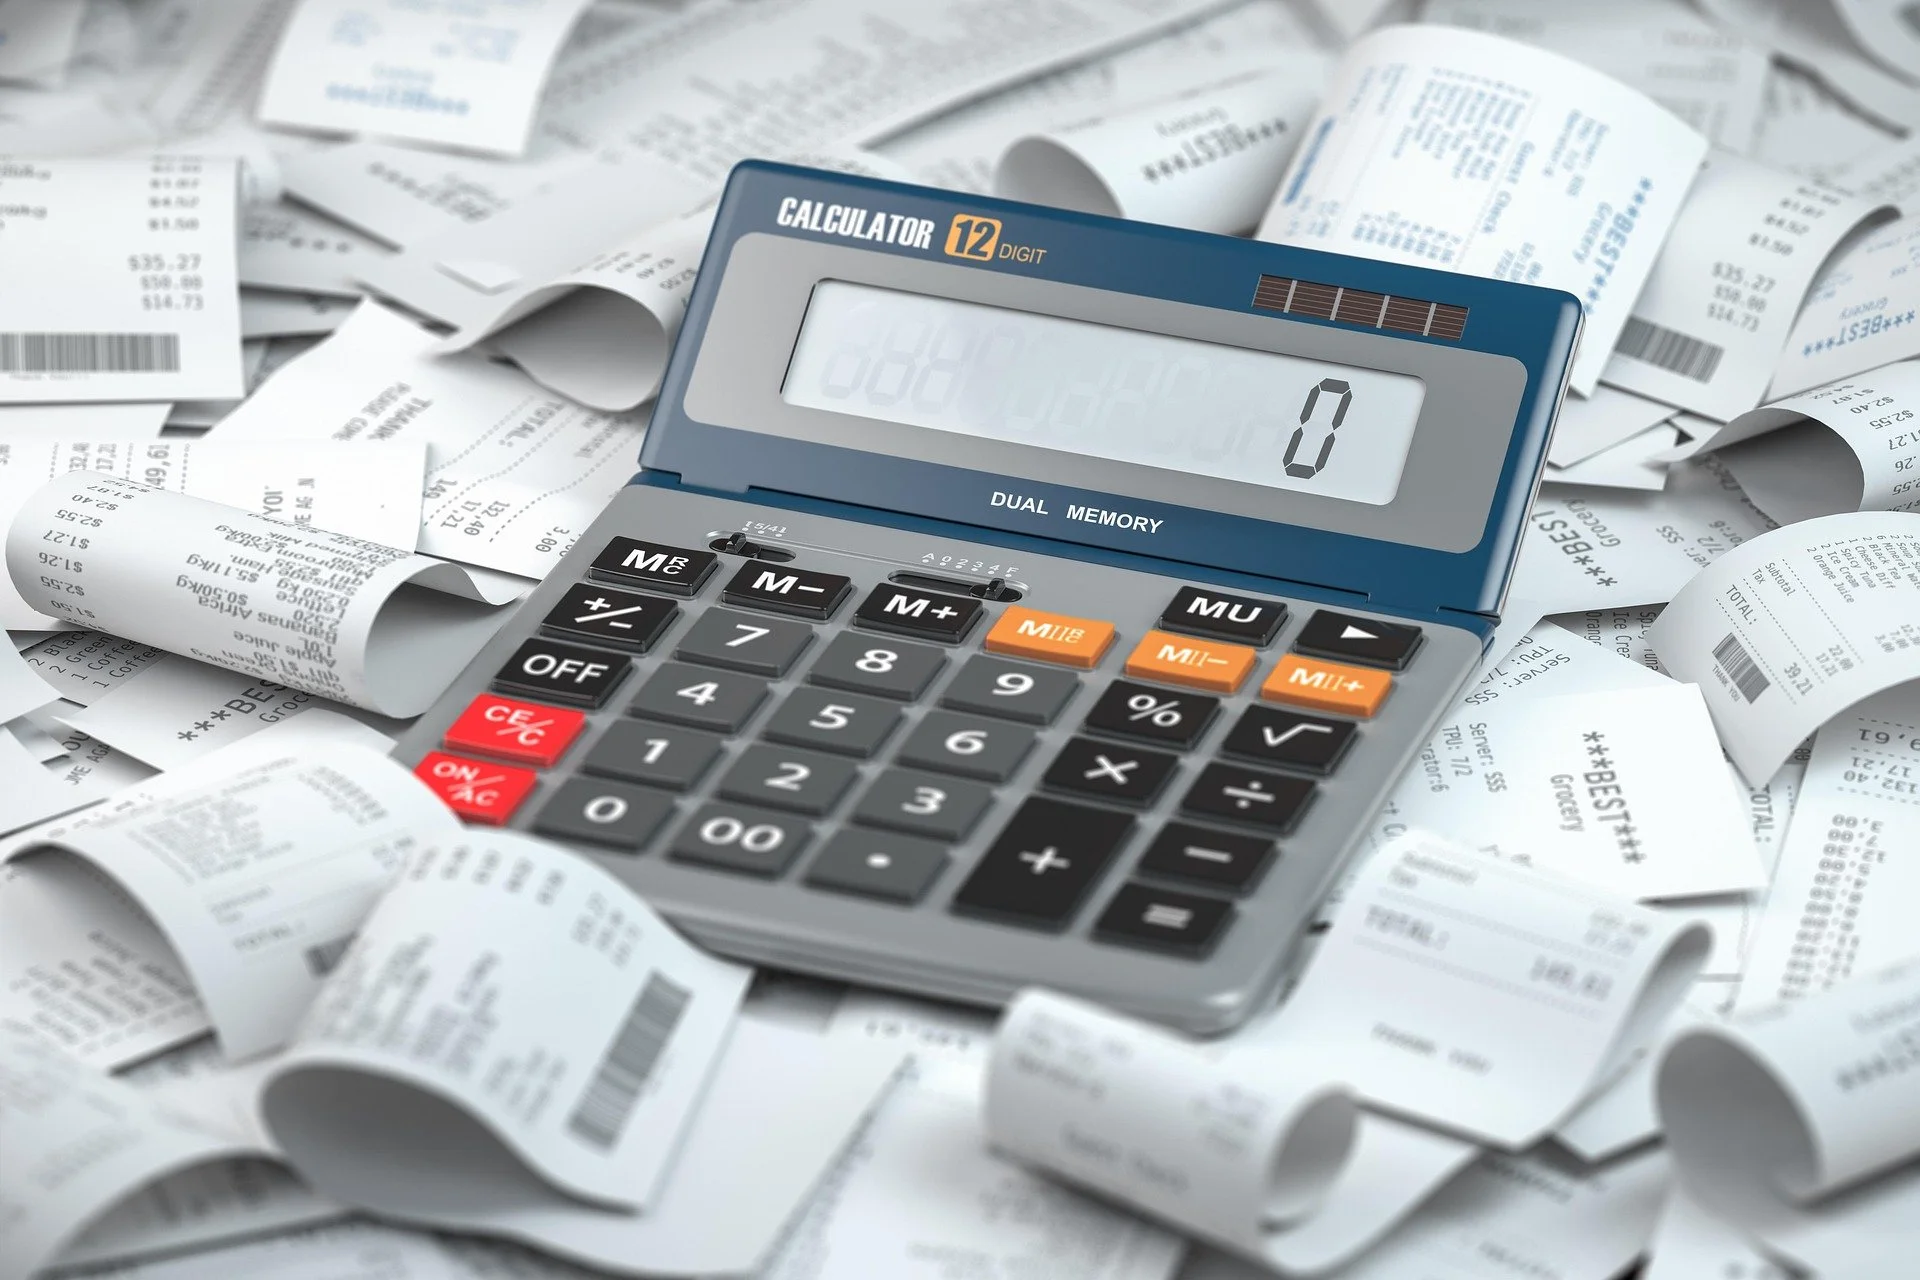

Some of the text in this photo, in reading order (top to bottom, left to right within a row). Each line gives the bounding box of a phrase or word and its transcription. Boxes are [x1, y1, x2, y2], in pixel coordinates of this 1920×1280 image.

[776, 196, 1047, 265] CALCULATOR 12 DIGIT
[1850, 396, 1894, 414] $2.40
[1283, 378, 1353, 479] 0
[1869, 410, 1914, 430] $2.55
[1888, 429, 1920, 450] 1.27
[144, 444, 171, 491] 49,61
[72, 494, 119, 511] $2.40
[990, 490, 1163, 534] DUAL MEMORY
[55, 509, 103, 528] $2.55
[463, 500, 511, 536] 132,40
[43, 529, 90, 550] $1.27
[535, 526, 570, 553] 3,00
[38, 552, 83, 573] $1.26
[186, 553, 260, 583] $5.11/kg
[957, 558, 969, 566] 2
[1006, 566, 1019, 574] F
[1827, 550, 1841, 565] Ice
[1839, 566, 1860, 588] Cream
[1840, 548, 1861, 569] Spicy
[1860, 571, 1876, 589] Tuna
[1855, 545, 1878, 570] Cheese
[1869, 543, 1890, 565] Black
[1888, 567, 1901, 580] Tea
[1882, 542, 1911, 570] Mineral
[40, 576, 85, 597] $2.55
[276, 578, 299, 595] kg
[1752, 568, 1767, 585] Tax
[1764, 562, 1796, 597] Subtotal
[1806, 546, 1855, 604] 2 Orange Juice
[176, 574, 248, 607] $0.50/kg
[1725, 584, 1757, 625] TOTAL:
[276, 591, 346, 619] Lettuce
[884, 594, 958, 621] M+
[1186, 597, 1262, 624] MU
[199, 596, 338, 645] Bananas Africa
[1612, 611, 1629, 630] Ice
[233, 630, 336, 668] Apple Juice
[724, 623, 771, 648] 7
[28, 657, 45, 666] 2
[49, 635, 113, 673] 2 Green
[854, 649, 899, 674] 8
[1511, 645, 1554, 665] TPU:
[522, 653, 609, 685] OFF
[1464, 653, 1571, 706] Server: SSS
[676, 681, 722, 707] 4
[992, 672, 1034, 697] 9
[809, 704, 856, 731] 5
[1127, 693, 1183, 728] %
[641, 738, 671, 764] 1
[944, 730, 988, 756] 6
[1442, 725, 1473, 777] TPU: 7/2
[1421, 742, 1450, 793] rator:6
[1469, 722, 1508, 793] Server: SSS
[1852, 756, 1911, 778] 17,21
[764, 762, 811, 791] 2
[1844, 769, 1918, 794] 132,40
[582, 796, 629, 825] 0
[902, 786, 948, 815] 3
[1549, 773, 1586, 833] Grocery
[699, 816, 786, 853] 00
